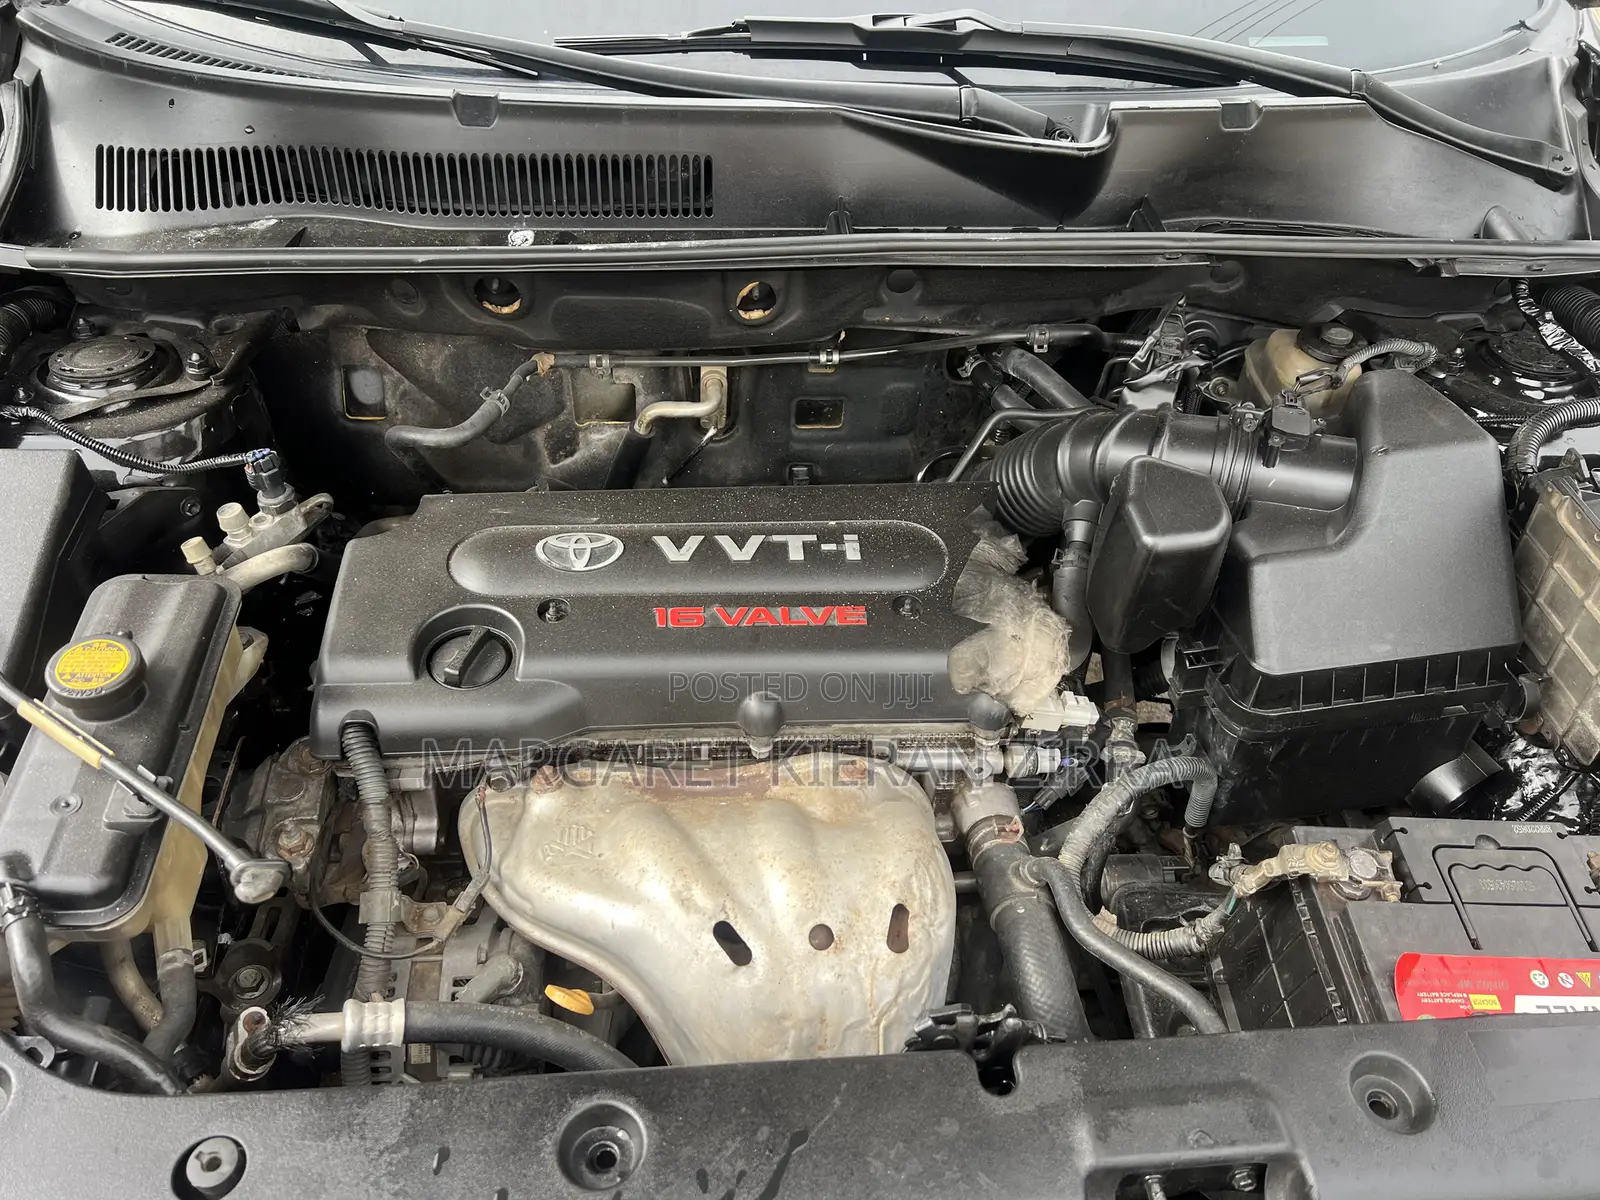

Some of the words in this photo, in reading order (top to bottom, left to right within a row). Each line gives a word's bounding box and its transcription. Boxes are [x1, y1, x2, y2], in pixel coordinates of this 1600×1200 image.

[651, 534, 862, 562] VVT-i
[653, 606, 705, 628] 16
[712, 605, 868, 627] VALVE
